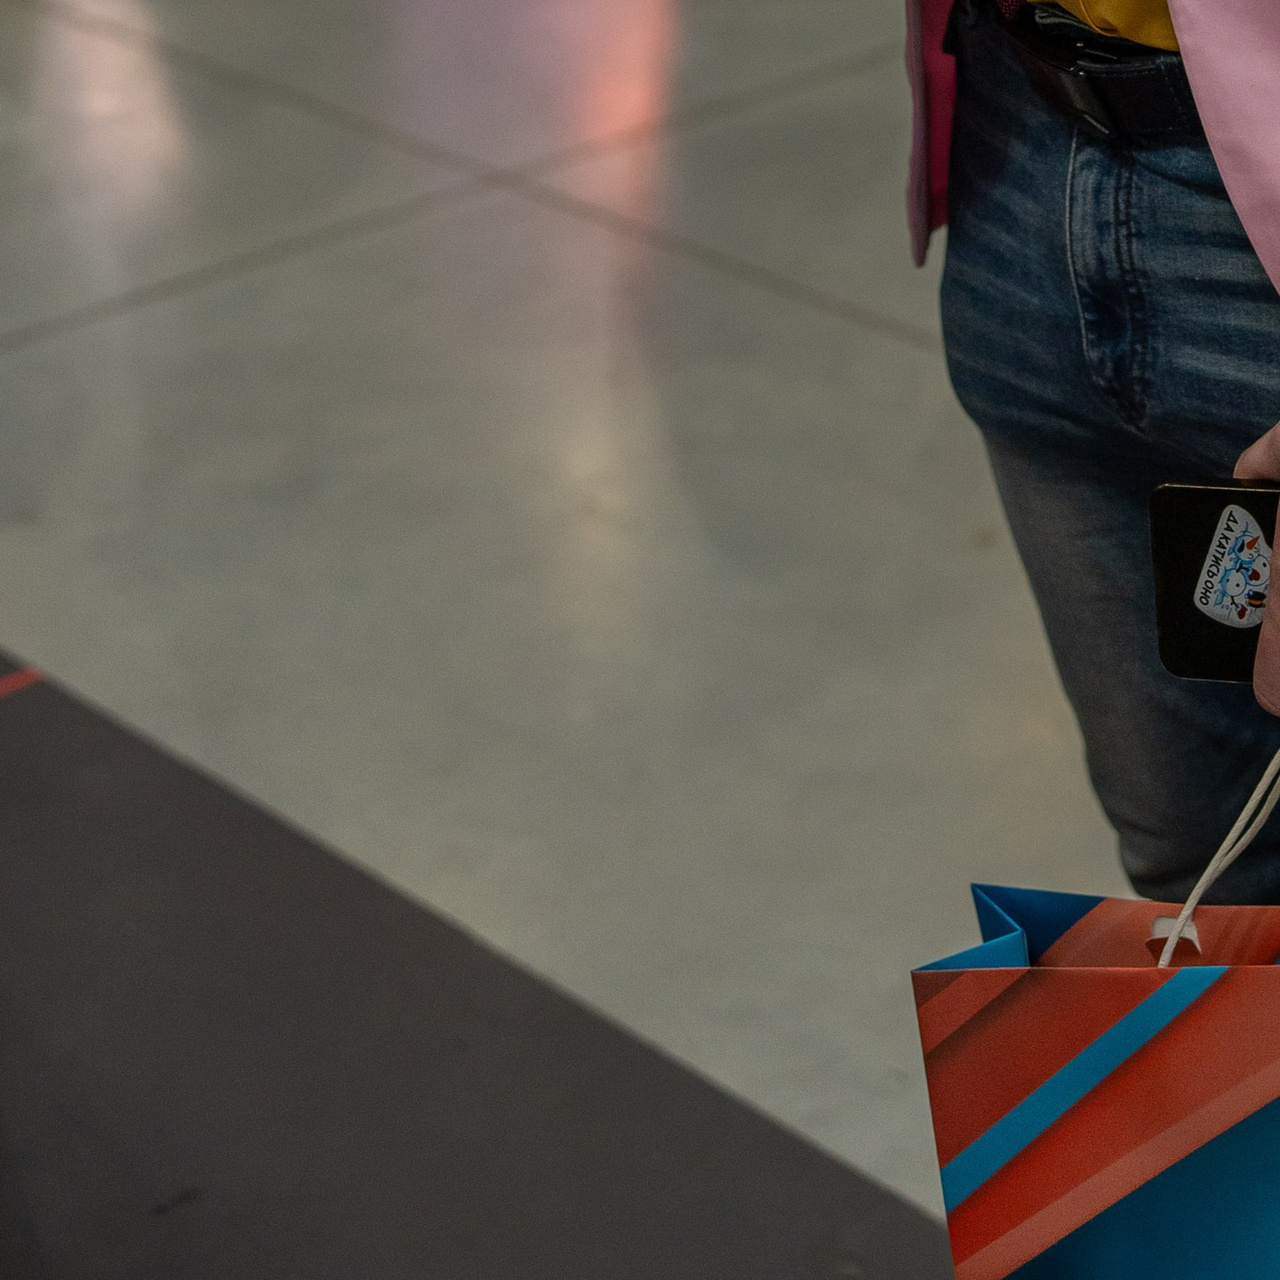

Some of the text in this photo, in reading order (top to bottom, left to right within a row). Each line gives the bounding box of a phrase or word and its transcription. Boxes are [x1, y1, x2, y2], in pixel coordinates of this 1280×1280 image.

[1199, 510, 1238, 606] ДА КАТИСЬ ОНО
